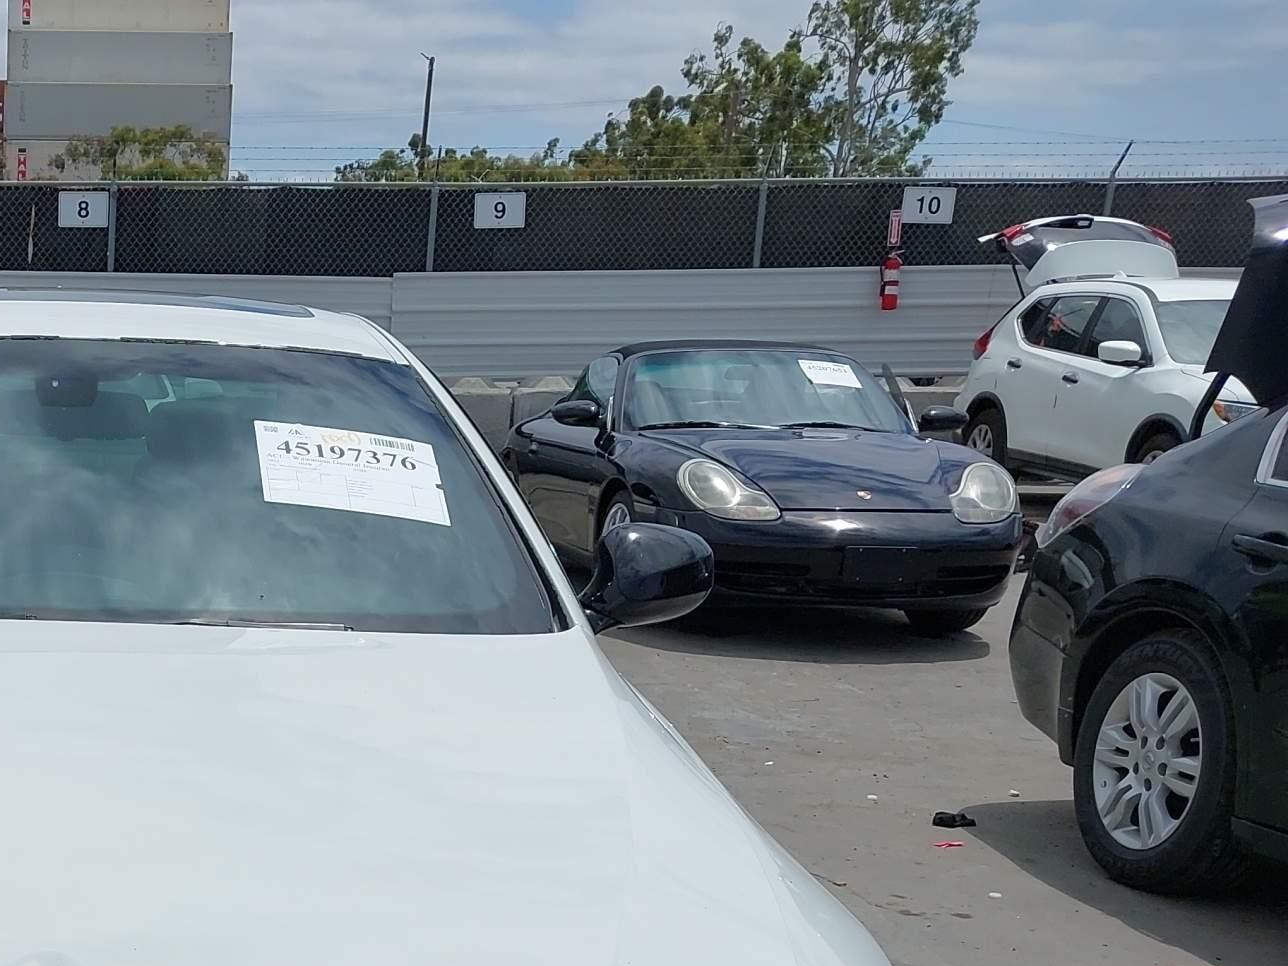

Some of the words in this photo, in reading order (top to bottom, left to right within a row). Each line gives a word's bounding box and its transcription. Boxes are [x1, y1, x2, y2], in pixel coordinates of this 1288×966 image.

[77, 200, 90, 219] 8
[493, 201, 507, 220] 9
[916, 195, 942, 215] 10
[276, 439, 417, 471] 45197376
